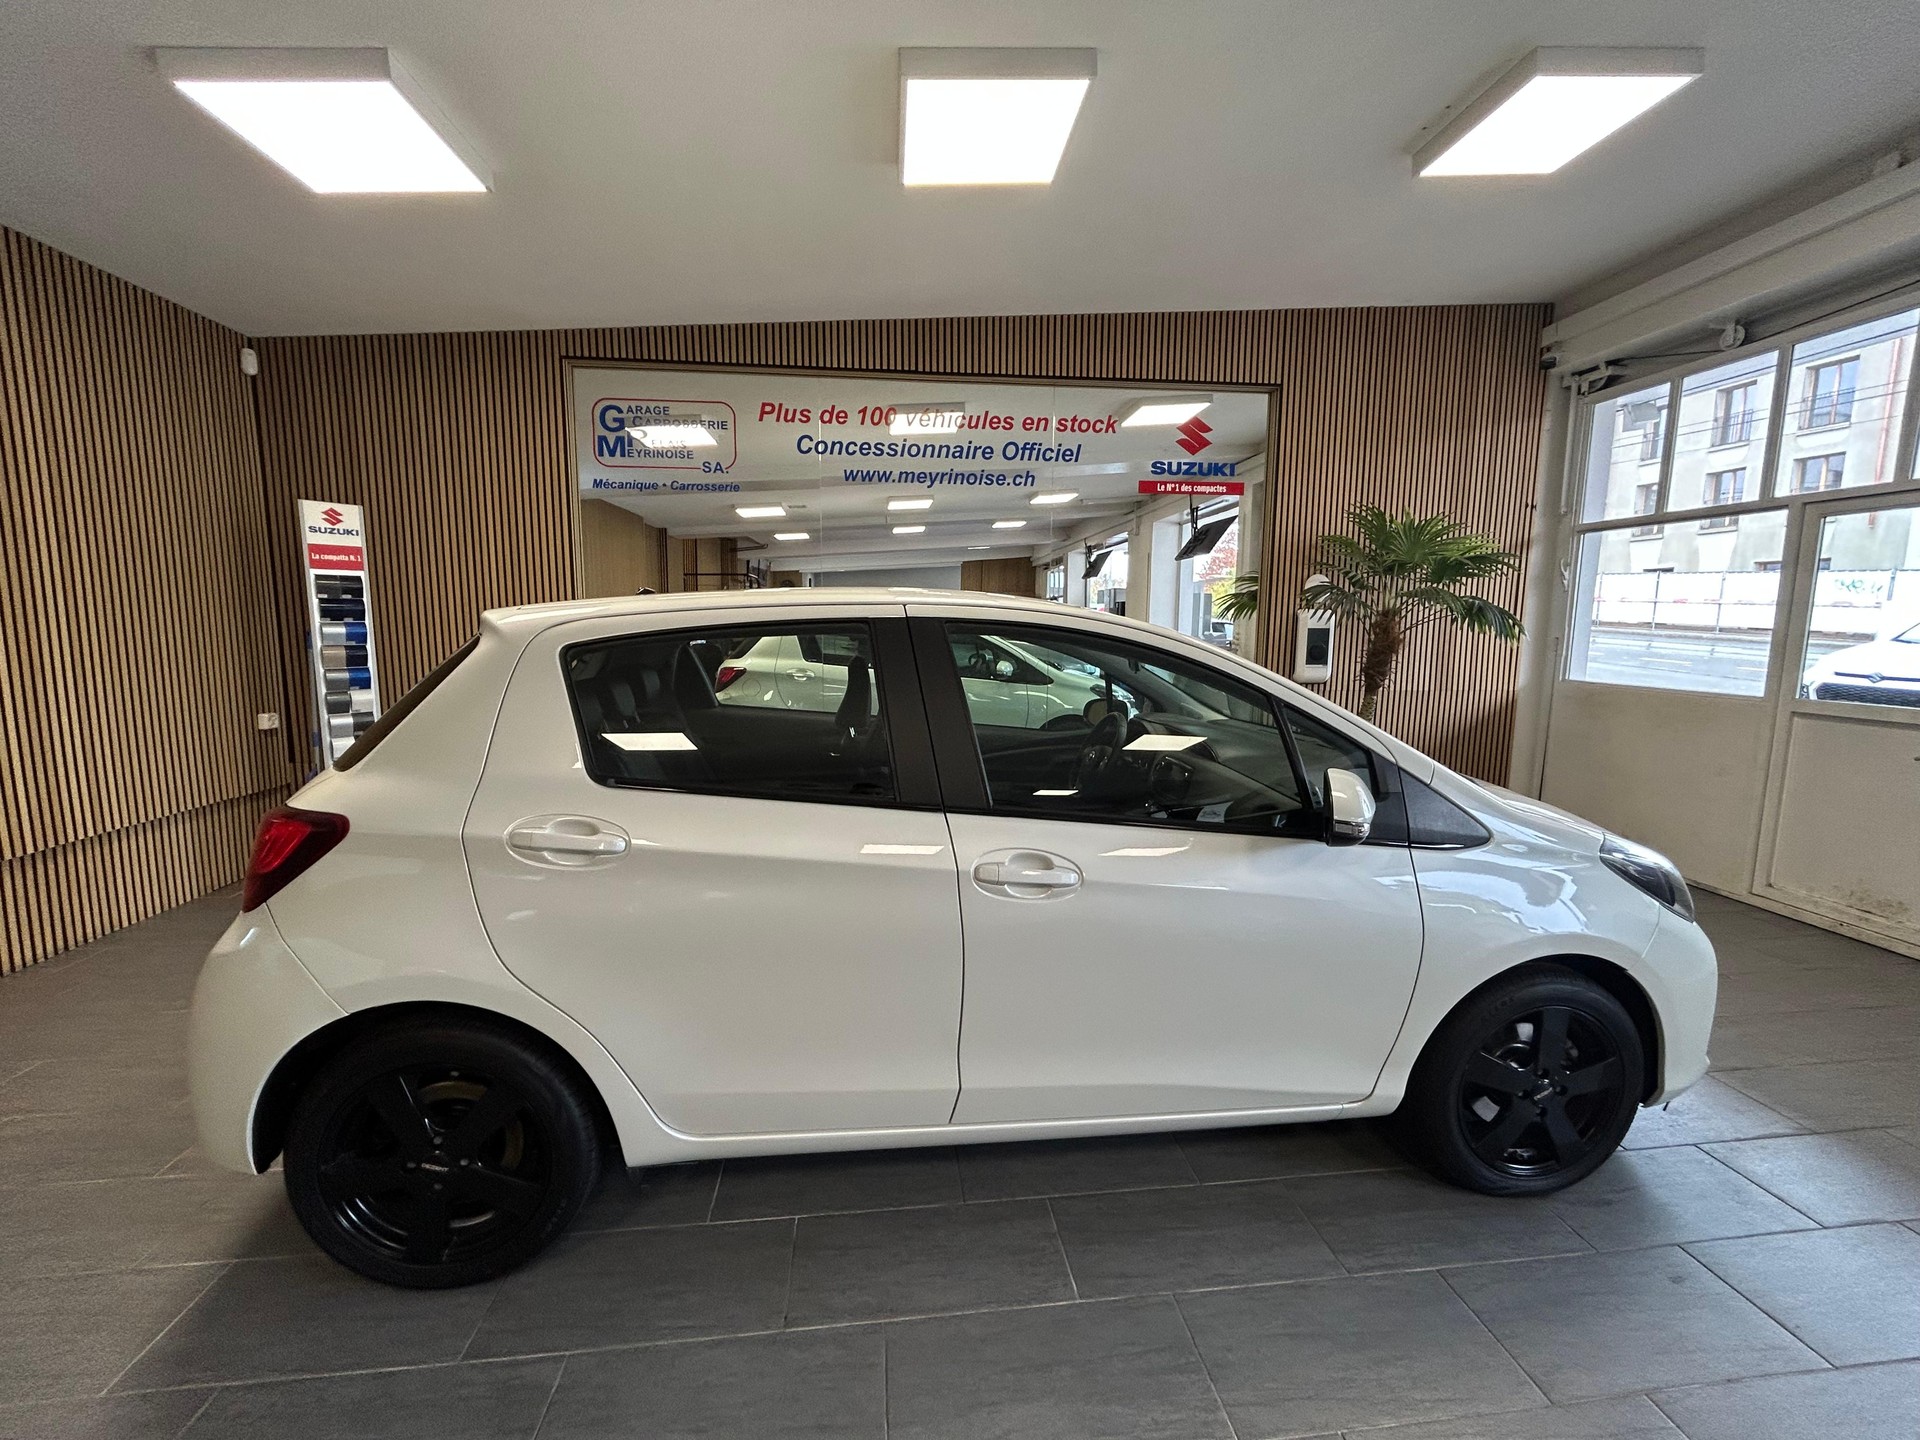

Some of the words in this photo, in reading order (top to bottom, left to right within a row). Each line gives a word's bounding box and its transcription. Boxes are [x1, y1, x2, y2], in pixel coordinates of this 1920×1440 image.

[758, 401, 811, 425] Plus
[819, 404, 849, 425] de
[857, 405, 896, 427] 100
[905, 408, 1014, 431] véhicules
[1021, 415, 1049, 432] en
[1055, 412, 1118, 434] stock
[797, 434, 994, 460] Concessionnaire
[1002, 440, 1081, 463] Officiel
[1150, 461, 1237, 477] SUZUKI
[592, 478, 659, 492] Mécanique
[670, 480, 740, 493] Carrosserie
[843, 468, 1036, 488] www.meyrinoise.ch
[1157, 483, 1165, 492] Le
[1181, 483, 1192, 492] des
[1193, 484, 1227, 494] compactes
[308, 526, 359, 536] SUZUKI
